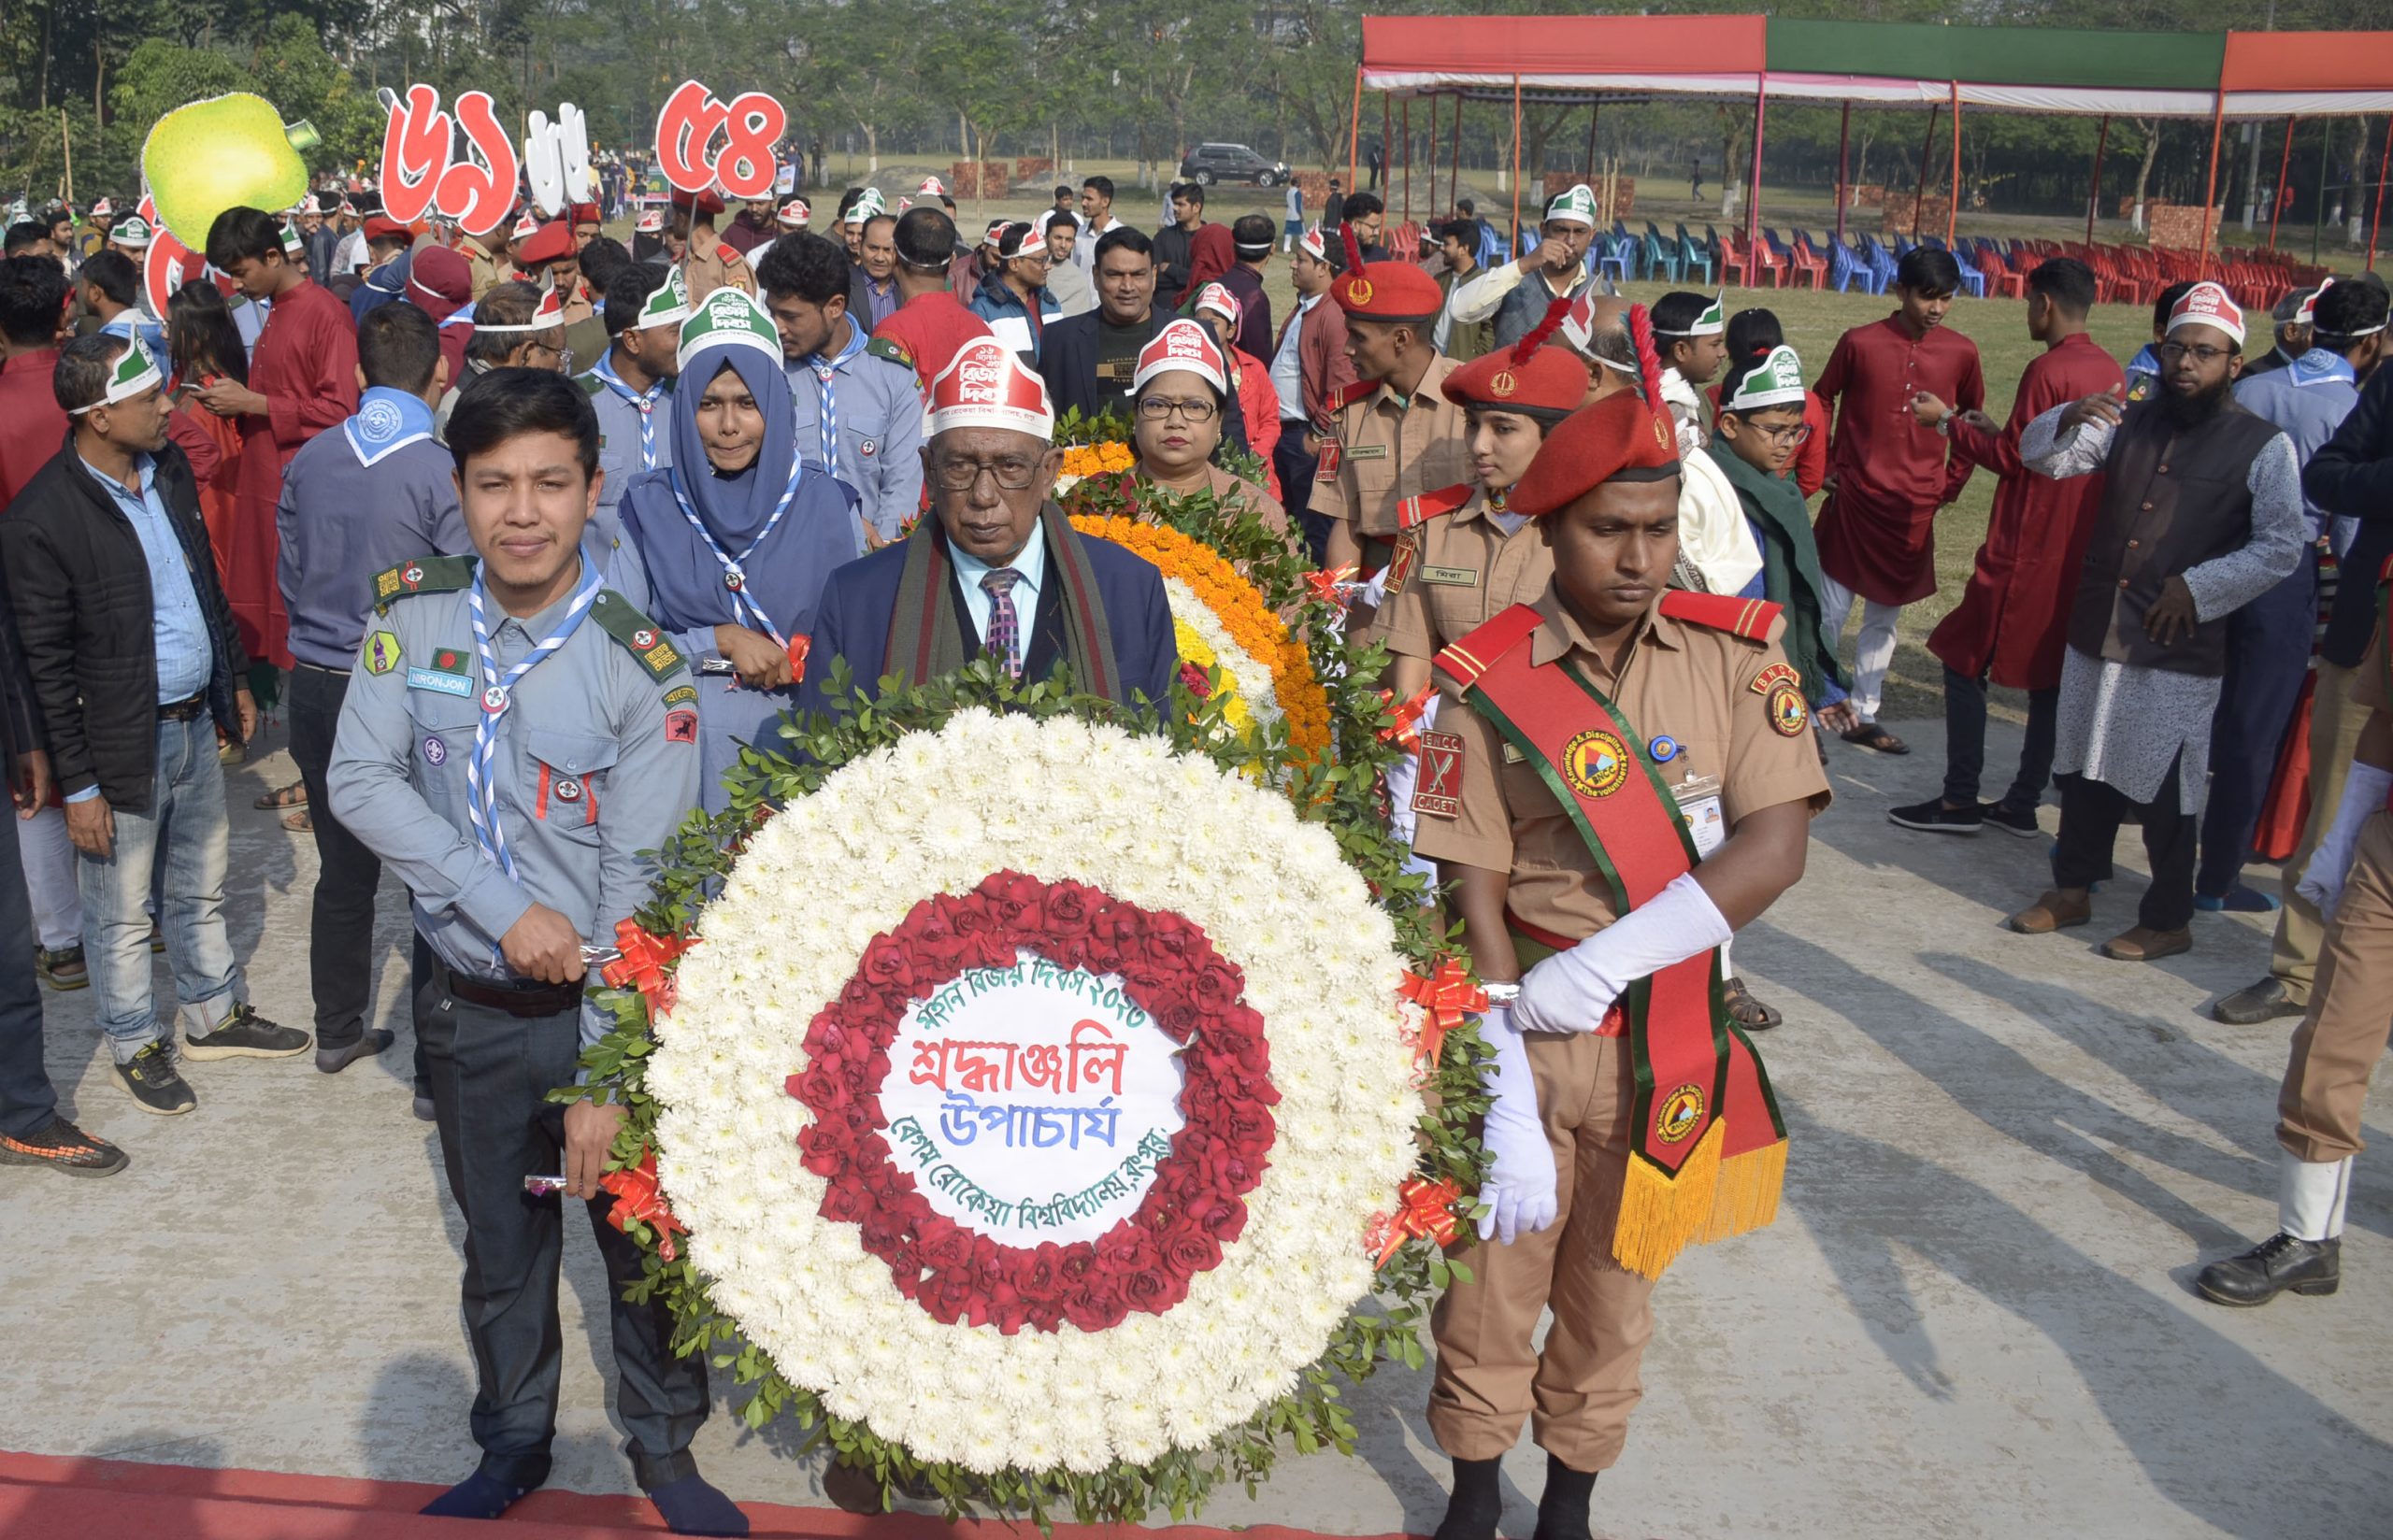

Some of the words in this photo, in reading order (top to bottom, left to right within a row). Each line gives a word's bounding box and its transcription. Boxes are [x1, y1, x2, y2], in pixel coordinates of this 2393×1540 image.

[1757, 665, 1795, 687] BNCC
[1426, 734, 1459, 749] BNCC
[1585, 730, 1623, 753] Discipline
[1591, 765, 1616, 785] BNCC
[1418, 796, 1455, 811] CADET
[916, 982, 967, 1030] মহান
[964, 961, 1026, 997] বিজয়
[1031, 956, 1090, 996] দিবস
[1089, 977, 1146, 1028] ২০২৩
[909, 1019, 1129, 1095] শ্রদ্ধাঞ্জলি
[939, 1089, 1123, 1150] উপাচার্য
[891, 1116, 942, 1168] বেগম
[929, 1164, 1014, 1226] রোকেয়া
